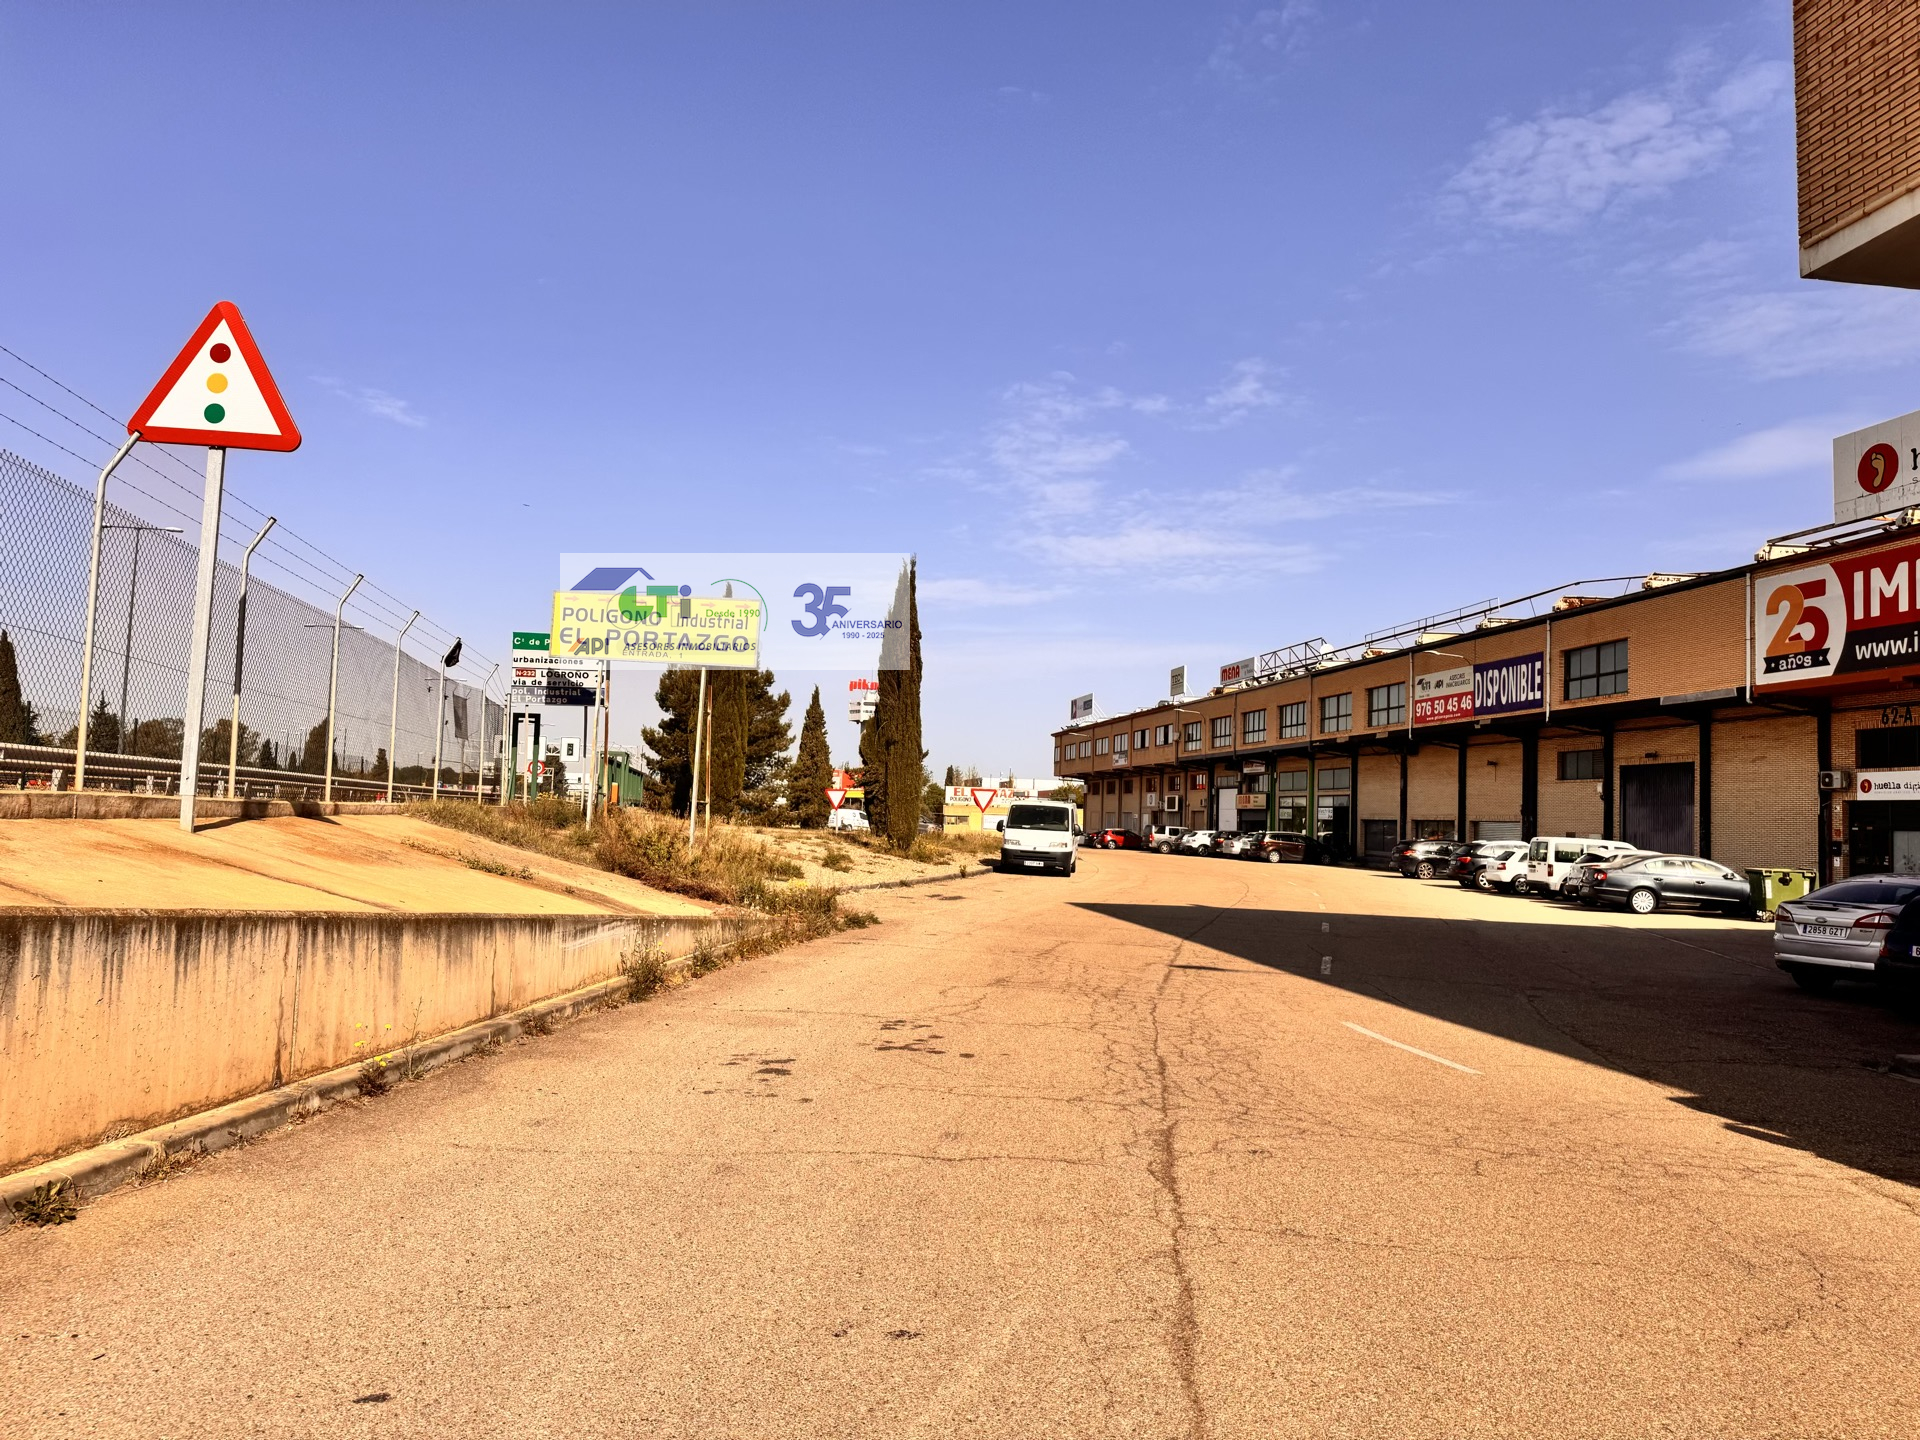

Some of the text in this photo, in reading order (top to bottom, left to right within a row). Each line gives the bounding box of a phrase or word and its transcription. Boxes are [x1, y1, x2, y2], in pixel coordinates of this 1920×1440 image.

[562, 607, 749, 630] POLIGONO Industrial
[1766, 579, 1829, 658] 25
[529, 638, 540, 646] de
[606, 629, 749, 653] PORTAZGO
[513, 655, 584, 665] urbanizaciones
[1778, 654, 1812, 671] años
[534, 688, 581, 697] Industrial
[1475, 661, 1541, 708] DISPONIBLE
[525, 696, 568, 704] Portazgo
[1416, 694, 1472, 717] 976 50 45 46
[1881, 706, 1913, 726] 62-A
[1873, 782, 1901, 791] huella
[1807, 925, 1844, 937] 2858 GZT
